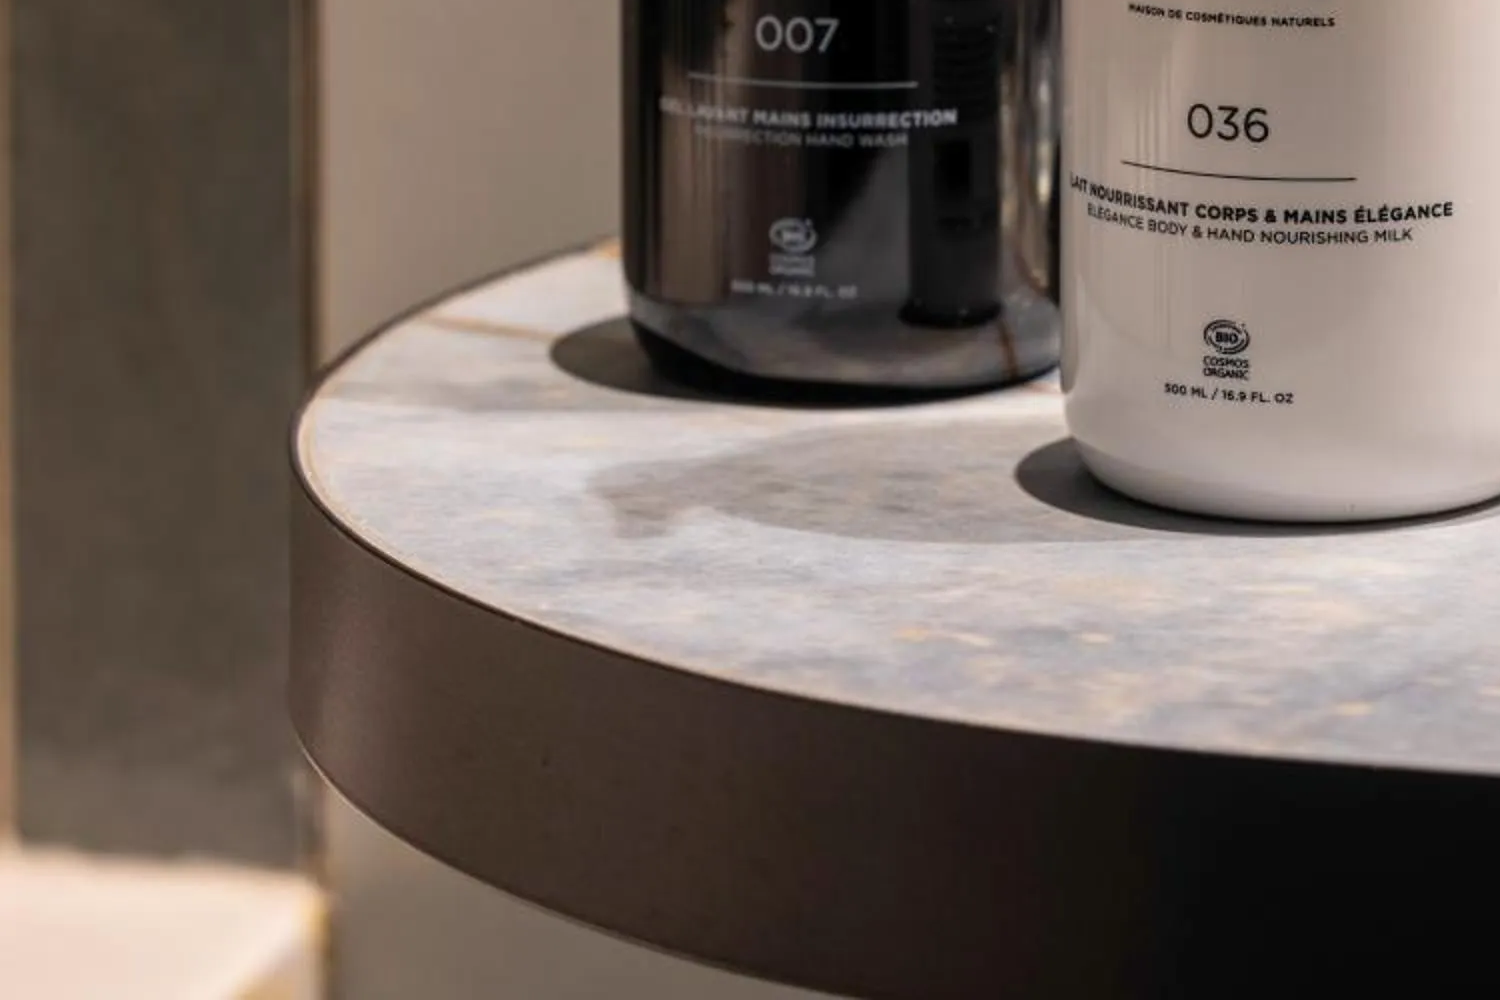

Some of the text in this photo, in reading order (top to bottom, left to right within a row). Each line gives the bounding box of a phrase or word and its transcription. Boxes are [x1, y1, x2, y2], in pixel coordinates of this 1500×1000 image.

[1128, 2, 1336, 28] MAISON DE COSMÉTIQUES NATURELS
[755, 15, 840, 53] 007
[752, 108, 811, 129] MAINS
[816, 107, 958, 129] INSURRECTION
[1187, 103, 1269, 143] 036
[858, 132, 909, 148] WASH
[1089, 183, 1189, 217] NOURRISSANT
[1195, 203, 1259, 223] CORPS
[1265, 209, 1277, 223] &
[1283, 208, 1348, 224] MAINS
[1353, 201, 1454, 224] ÉLÉGANCE
[1147, 218, 1188, 237] BODY
[1191, 225, 1203, 239] &
[1206, 226, 1256, 244] HAND
[1259, 229, 1369, 245] NOURISHING
[1373, 227, 1414, 243] MILK
[1215, 331, 1239, 344] BIO
[1203, 355, 1249, 369] COSMOS
[1203, 367, 1249, 381] ORGANIC
[1164, 382, 1187, 395] 500
[1191, 385, 1208, 400] ML
[1211, 387, 1219, 401] /
[1222, 389, 1247, 402] 16.9
[1274, 392, 1295, 404] OZ
